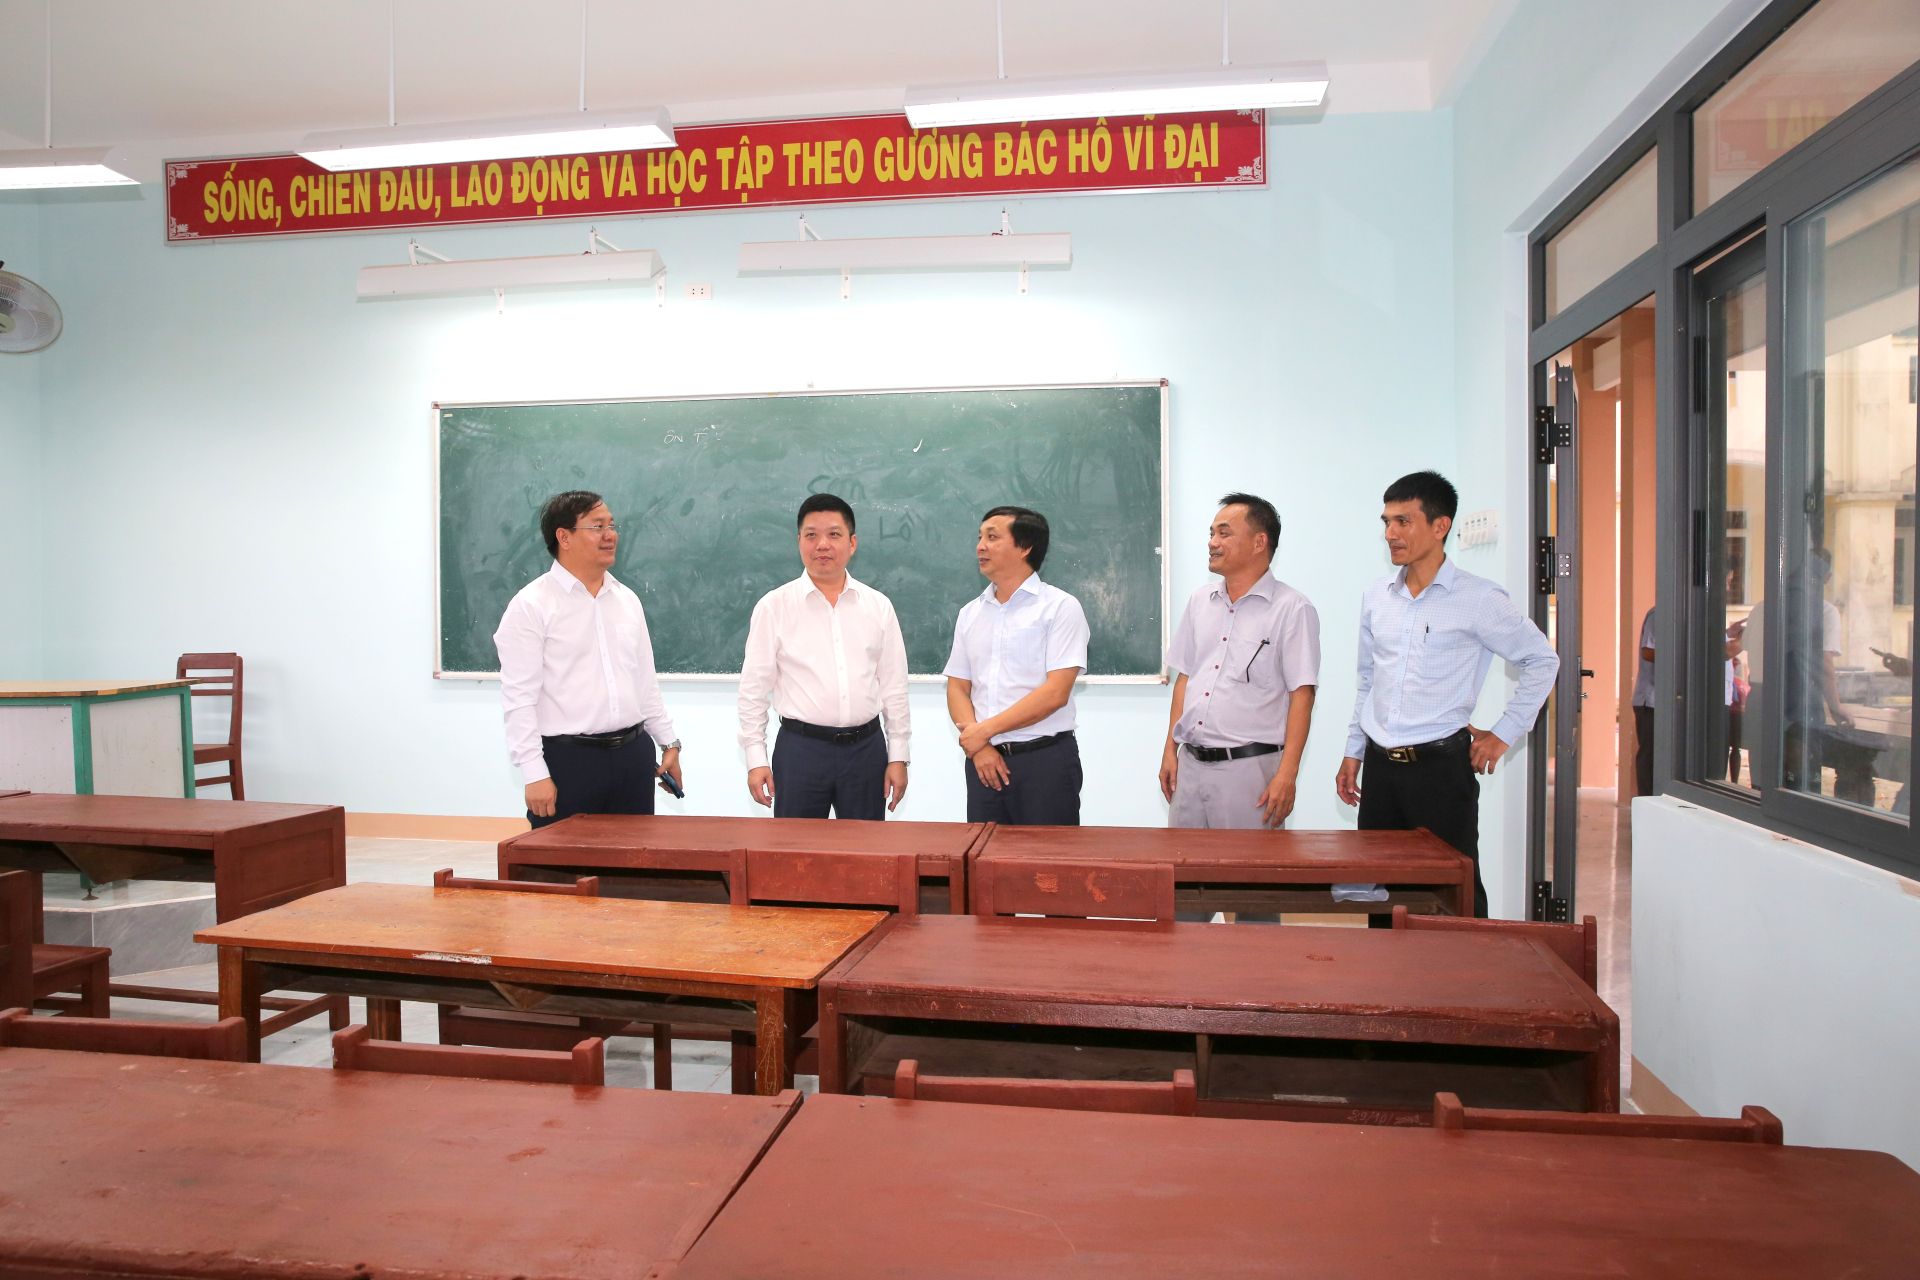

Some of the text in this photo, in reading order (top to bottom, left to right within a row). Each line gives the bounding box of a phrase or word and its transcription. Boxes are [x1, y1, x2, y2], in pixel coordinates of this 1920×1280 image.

[204, 162, 281, 227] SỐNG,
[451, 163, 503, 207] LAO
[647, 150, 707, 206] HỌC
[717, 136, 774, 204] TẬP
[783, 142, 864, 187] THEO
[994, 121, 1057, 176] BÁC
[1164, 122, 1219, 182] ĐẠI
